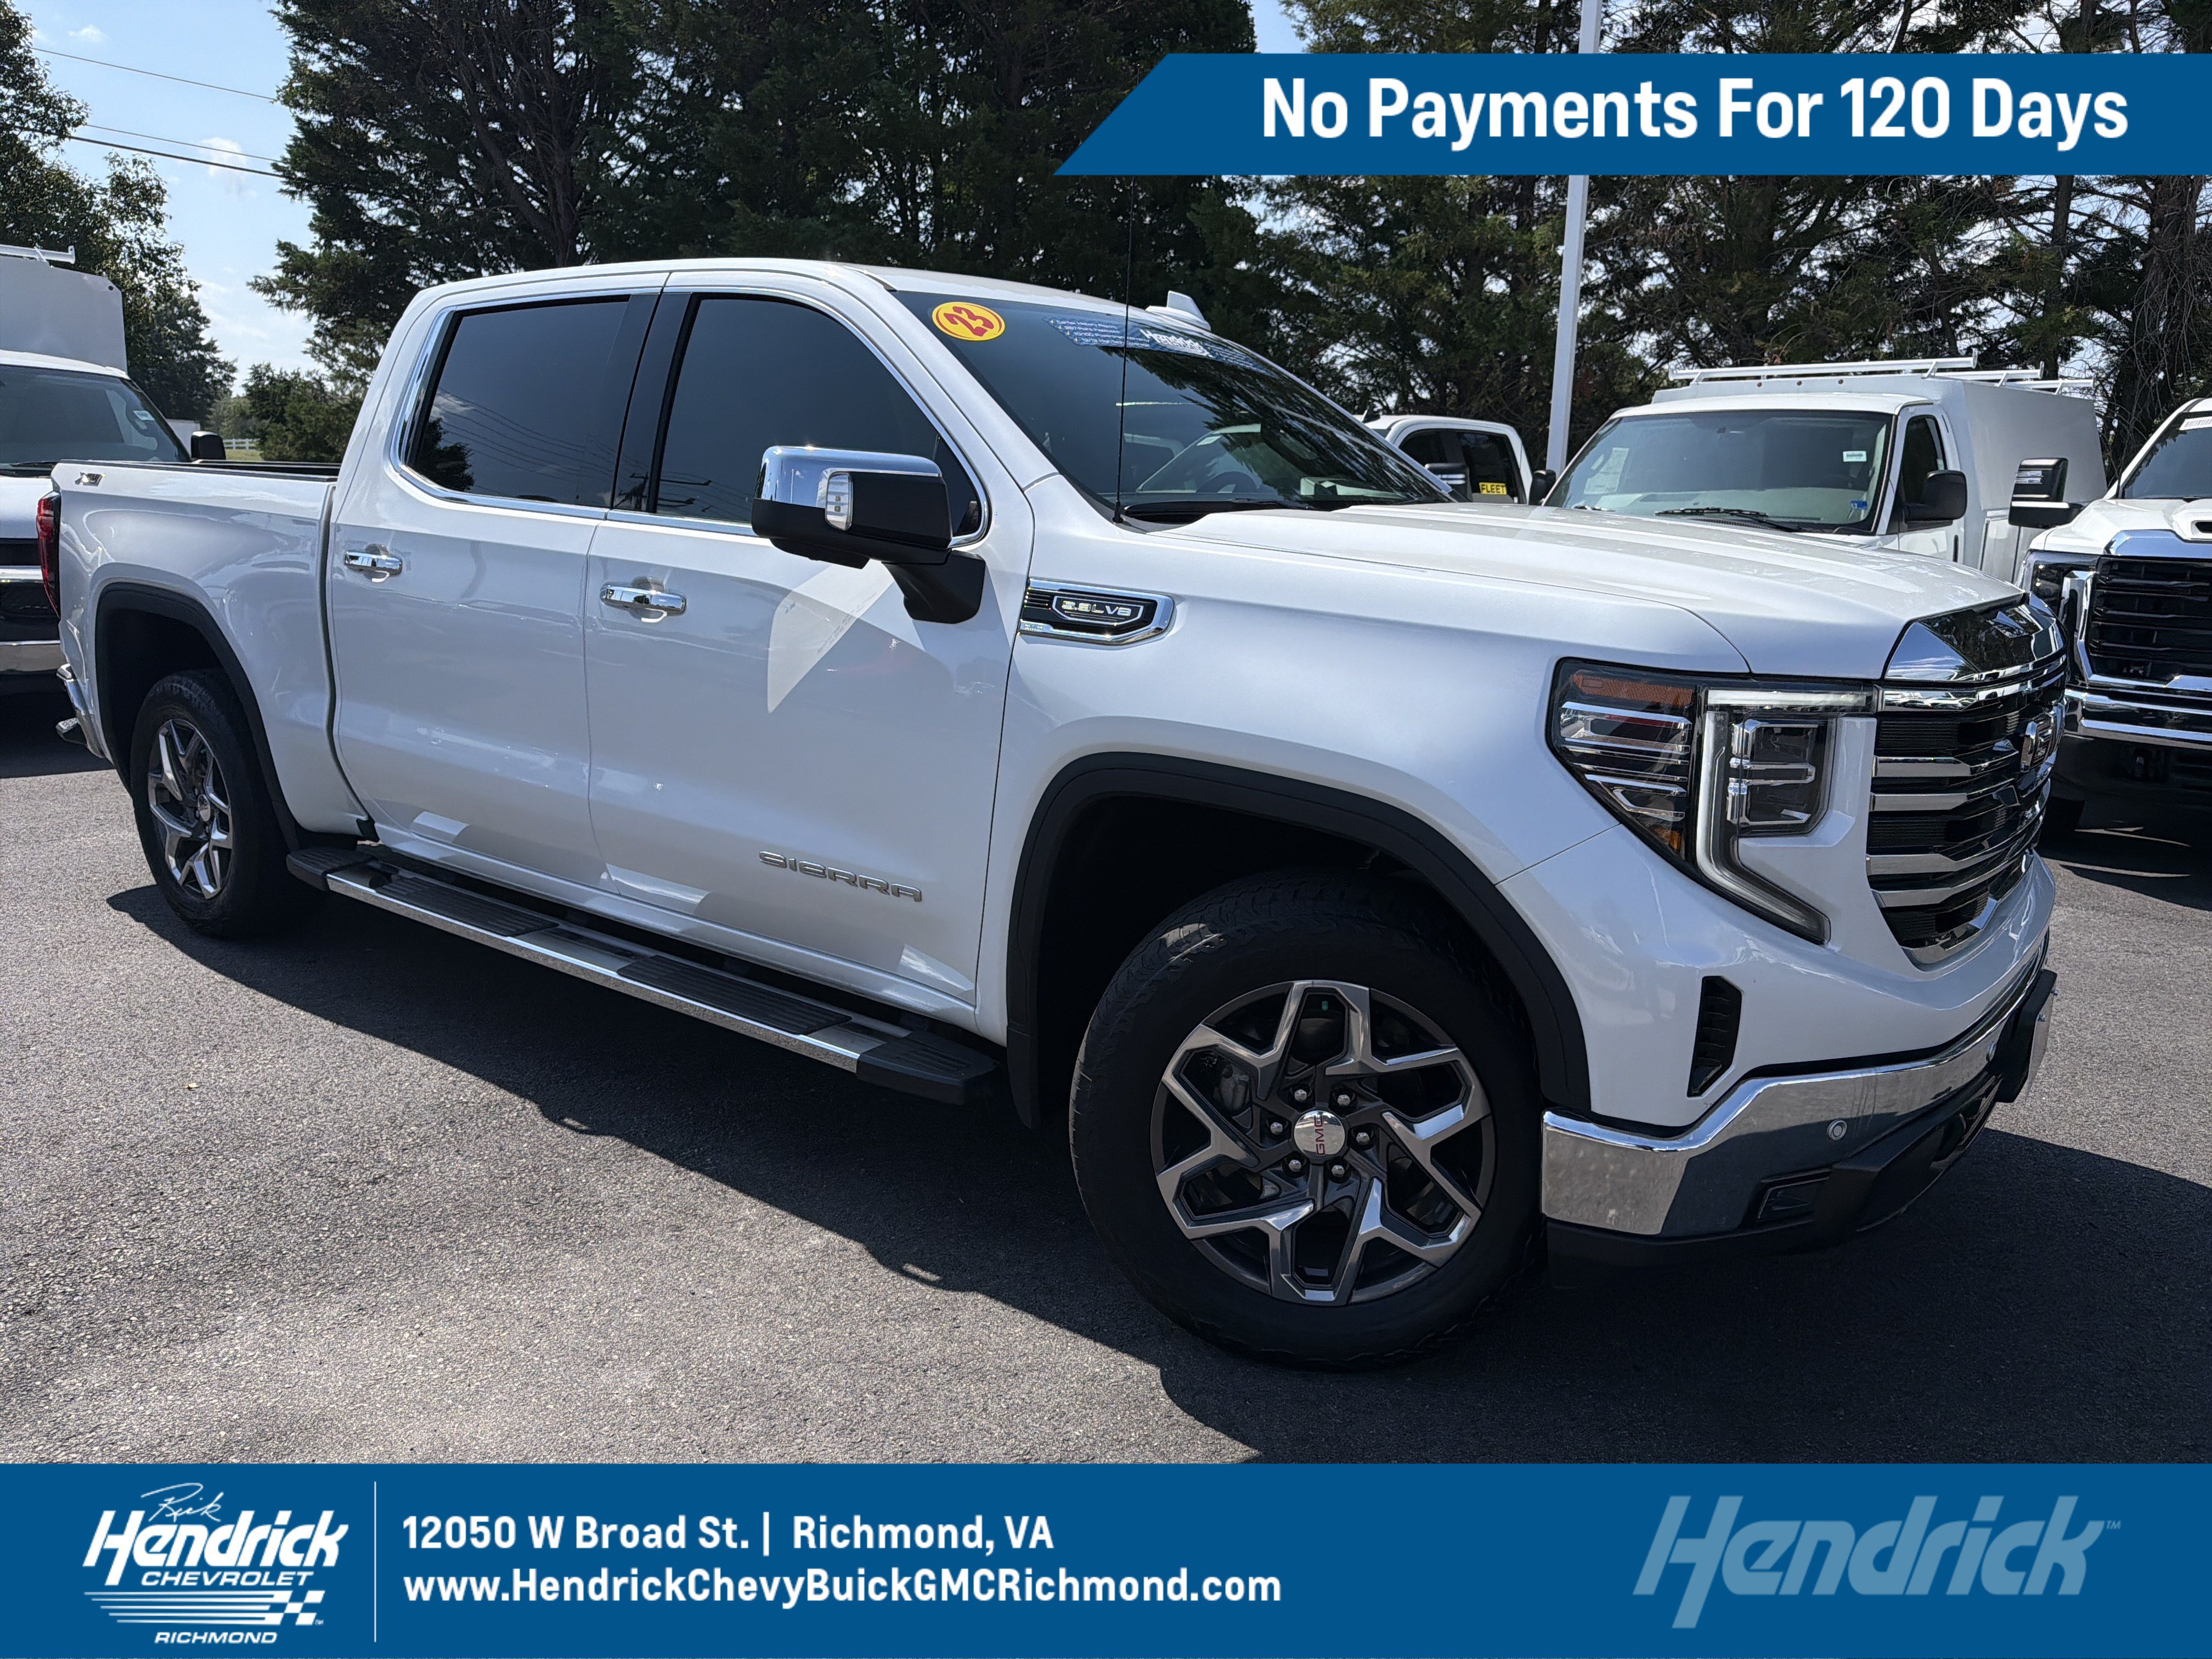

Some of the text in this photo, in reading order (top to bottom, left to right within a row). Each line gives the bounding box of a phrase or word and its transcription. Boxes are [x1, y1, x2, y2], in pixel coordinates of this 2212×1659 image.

[943, 306, 995, 337] 23
[1481, 484, 1505, 494] FLEET
[759, 850, 922, 902] SIERRA
[1314, 1115, 1325, 1156] GMC
